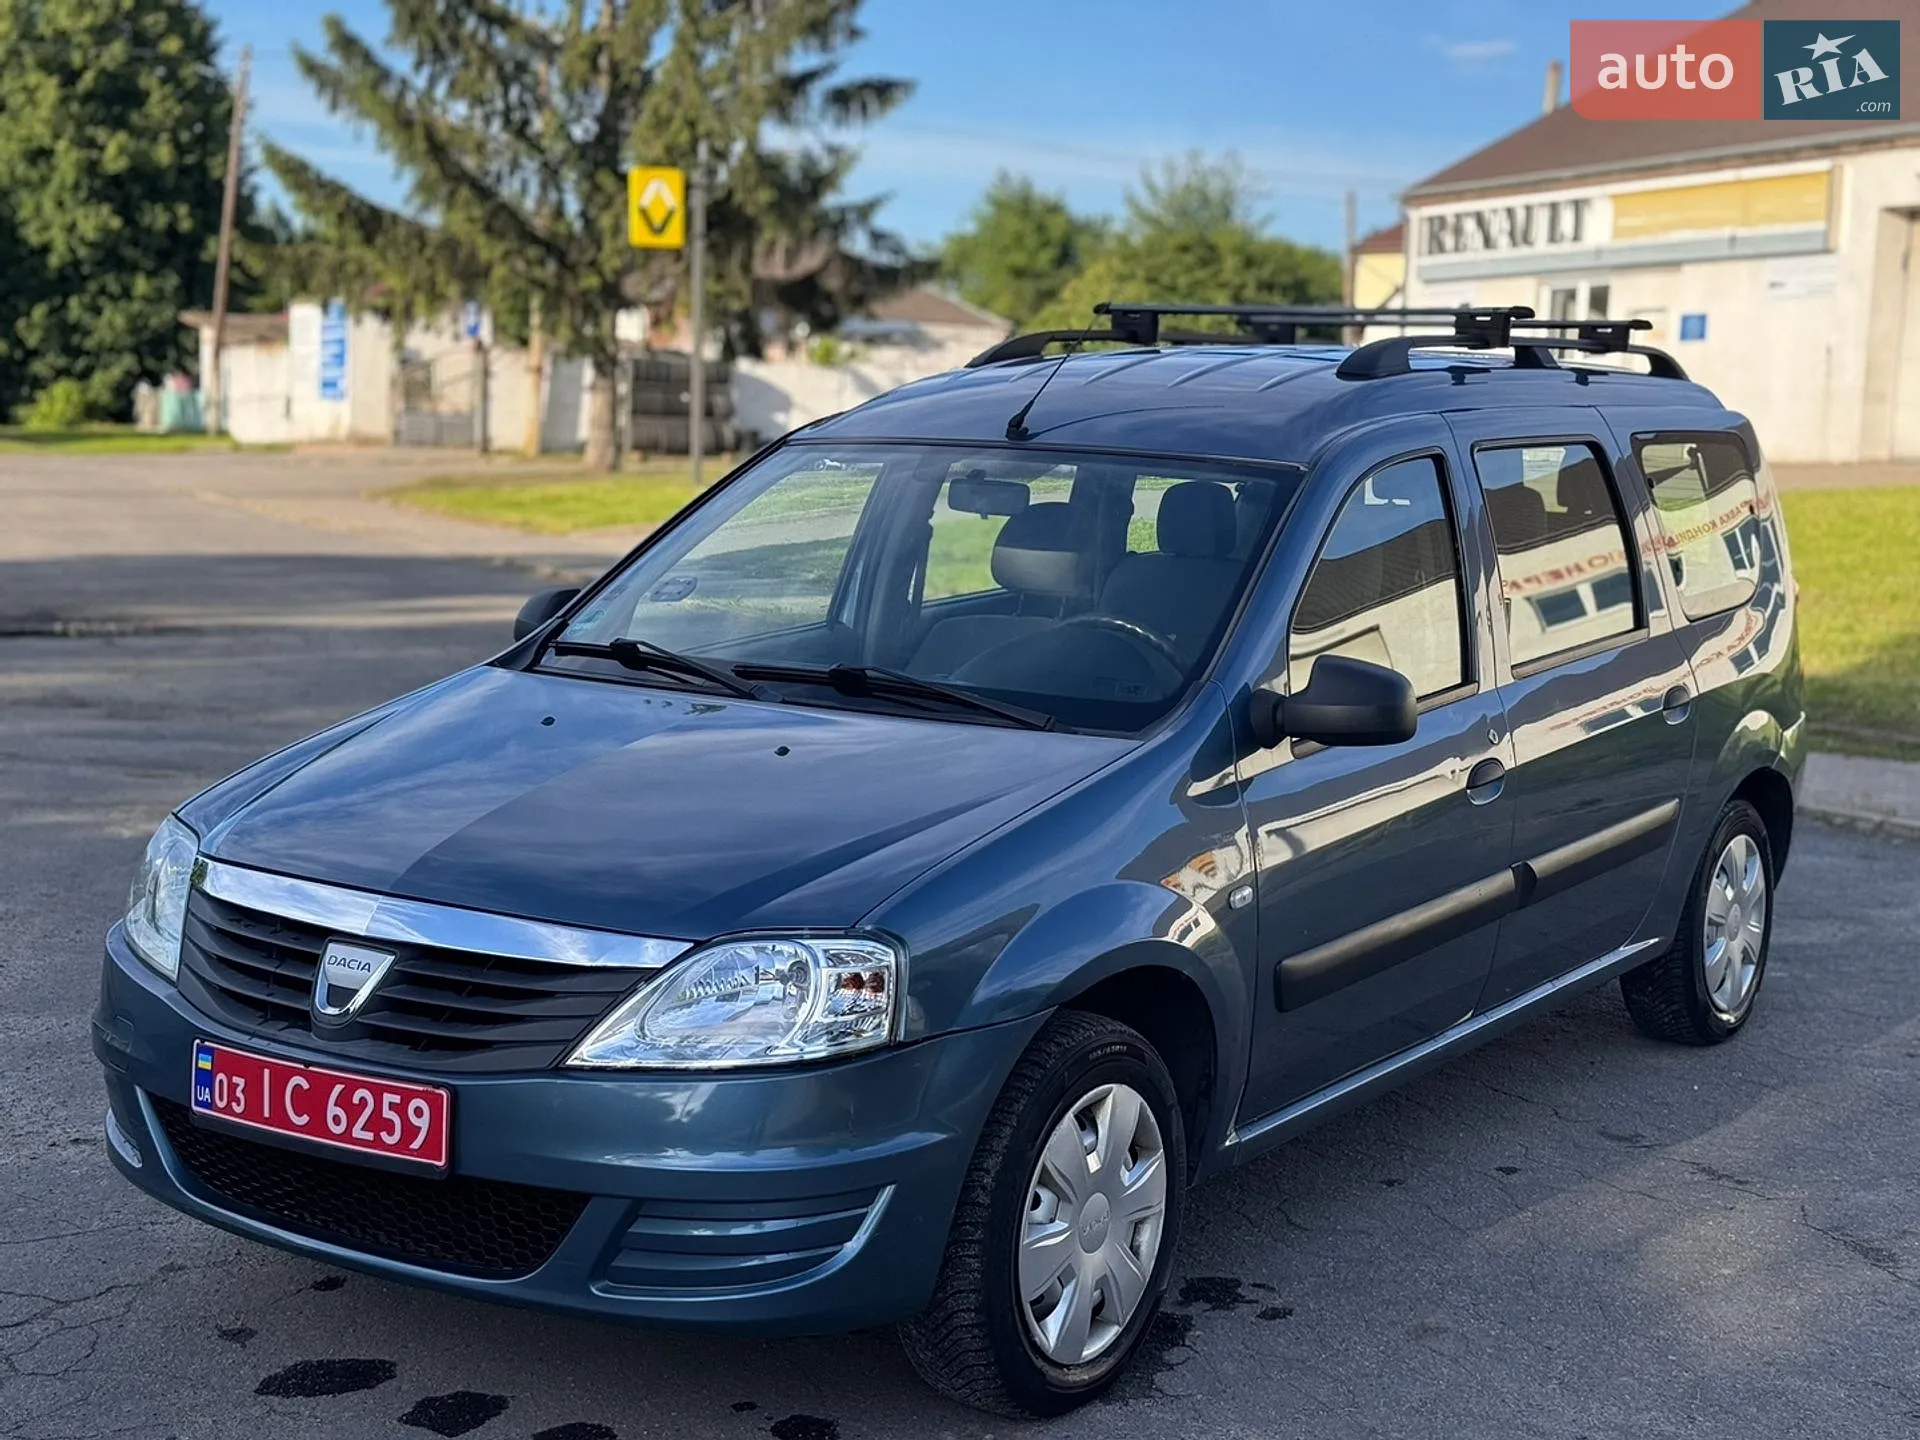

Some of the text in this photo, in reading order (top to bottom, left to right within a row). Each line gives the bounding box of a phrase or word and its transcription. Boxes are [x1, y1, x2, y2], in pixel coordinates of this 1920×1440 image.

[1428, 199, 1591, 255] RENAULT
[327, 954, 371, 973] DACIA
[197, 1085, 211, 1103] UA
[214, 1072, 246, 1114] 03
[326, 1083, 431, 1150] 6259
